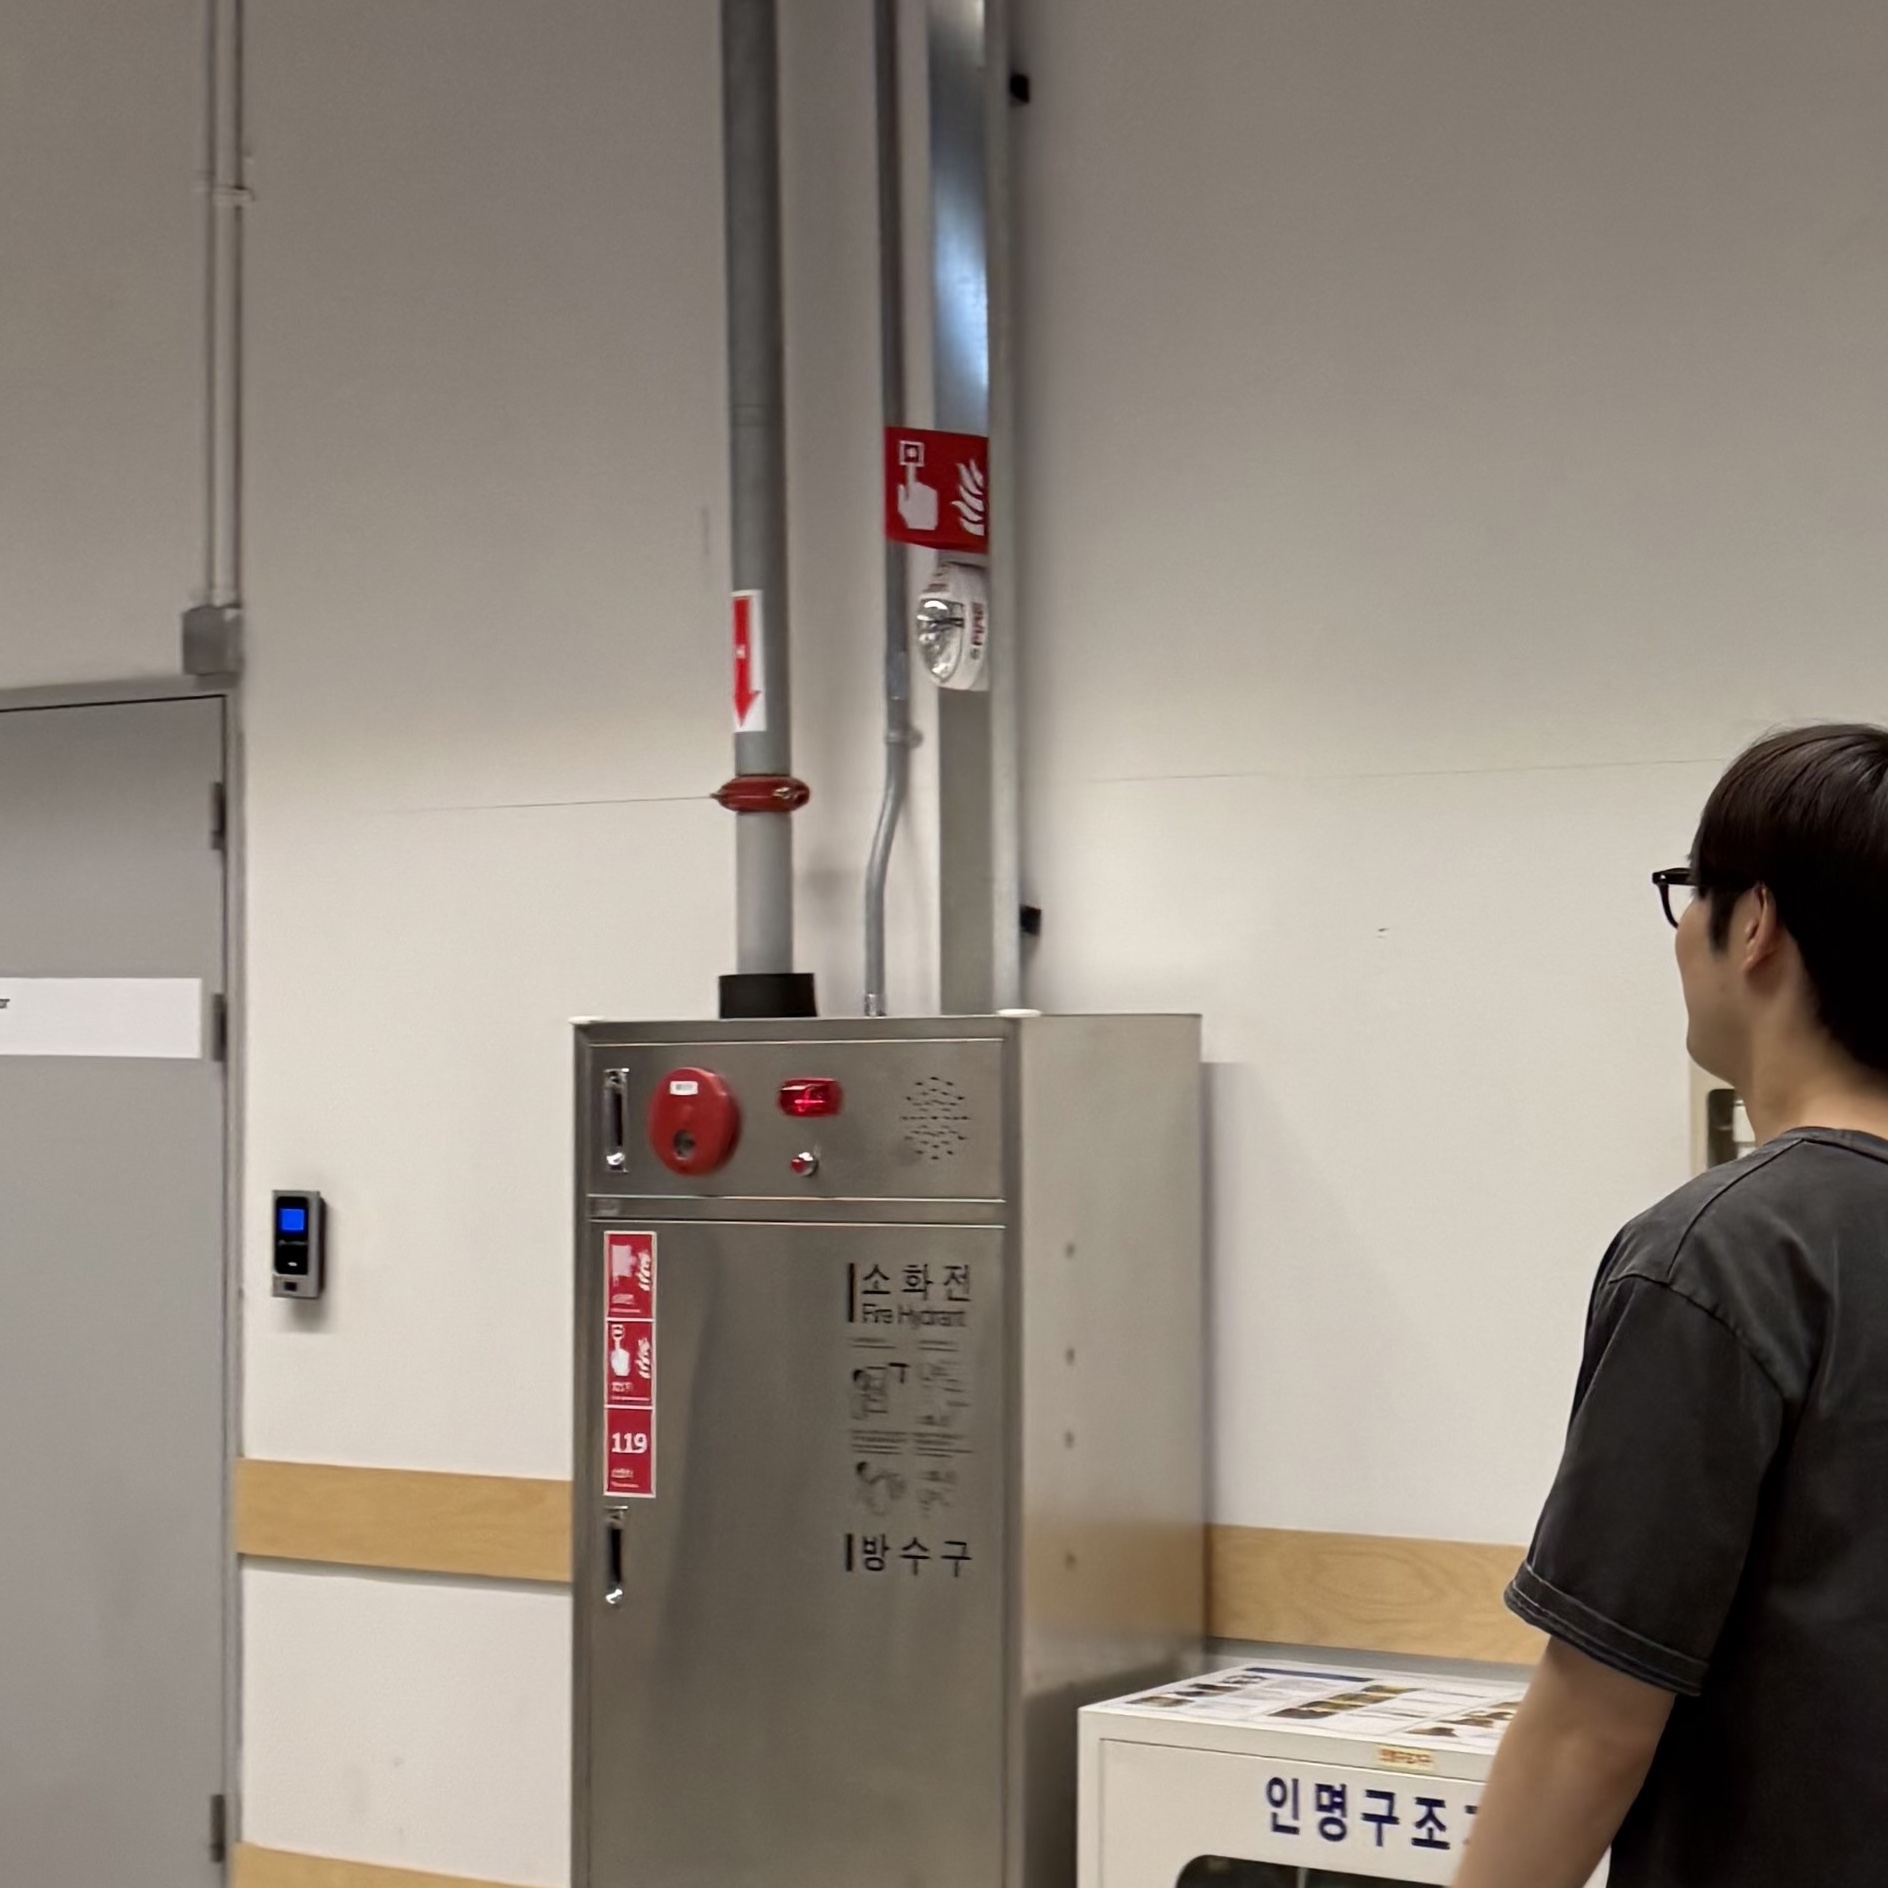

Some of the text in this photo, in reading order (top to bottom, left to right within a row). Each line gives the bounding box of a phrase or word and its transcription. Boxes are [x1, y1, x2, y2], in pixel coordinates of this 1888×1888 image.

[861, 1263, 973, 1302] 소화전
[610, 1431, 648, 1454] 119
[862, 1533, 973, 1578] 방수구
[1265, 1776, 1479, 1850] 인명구조
